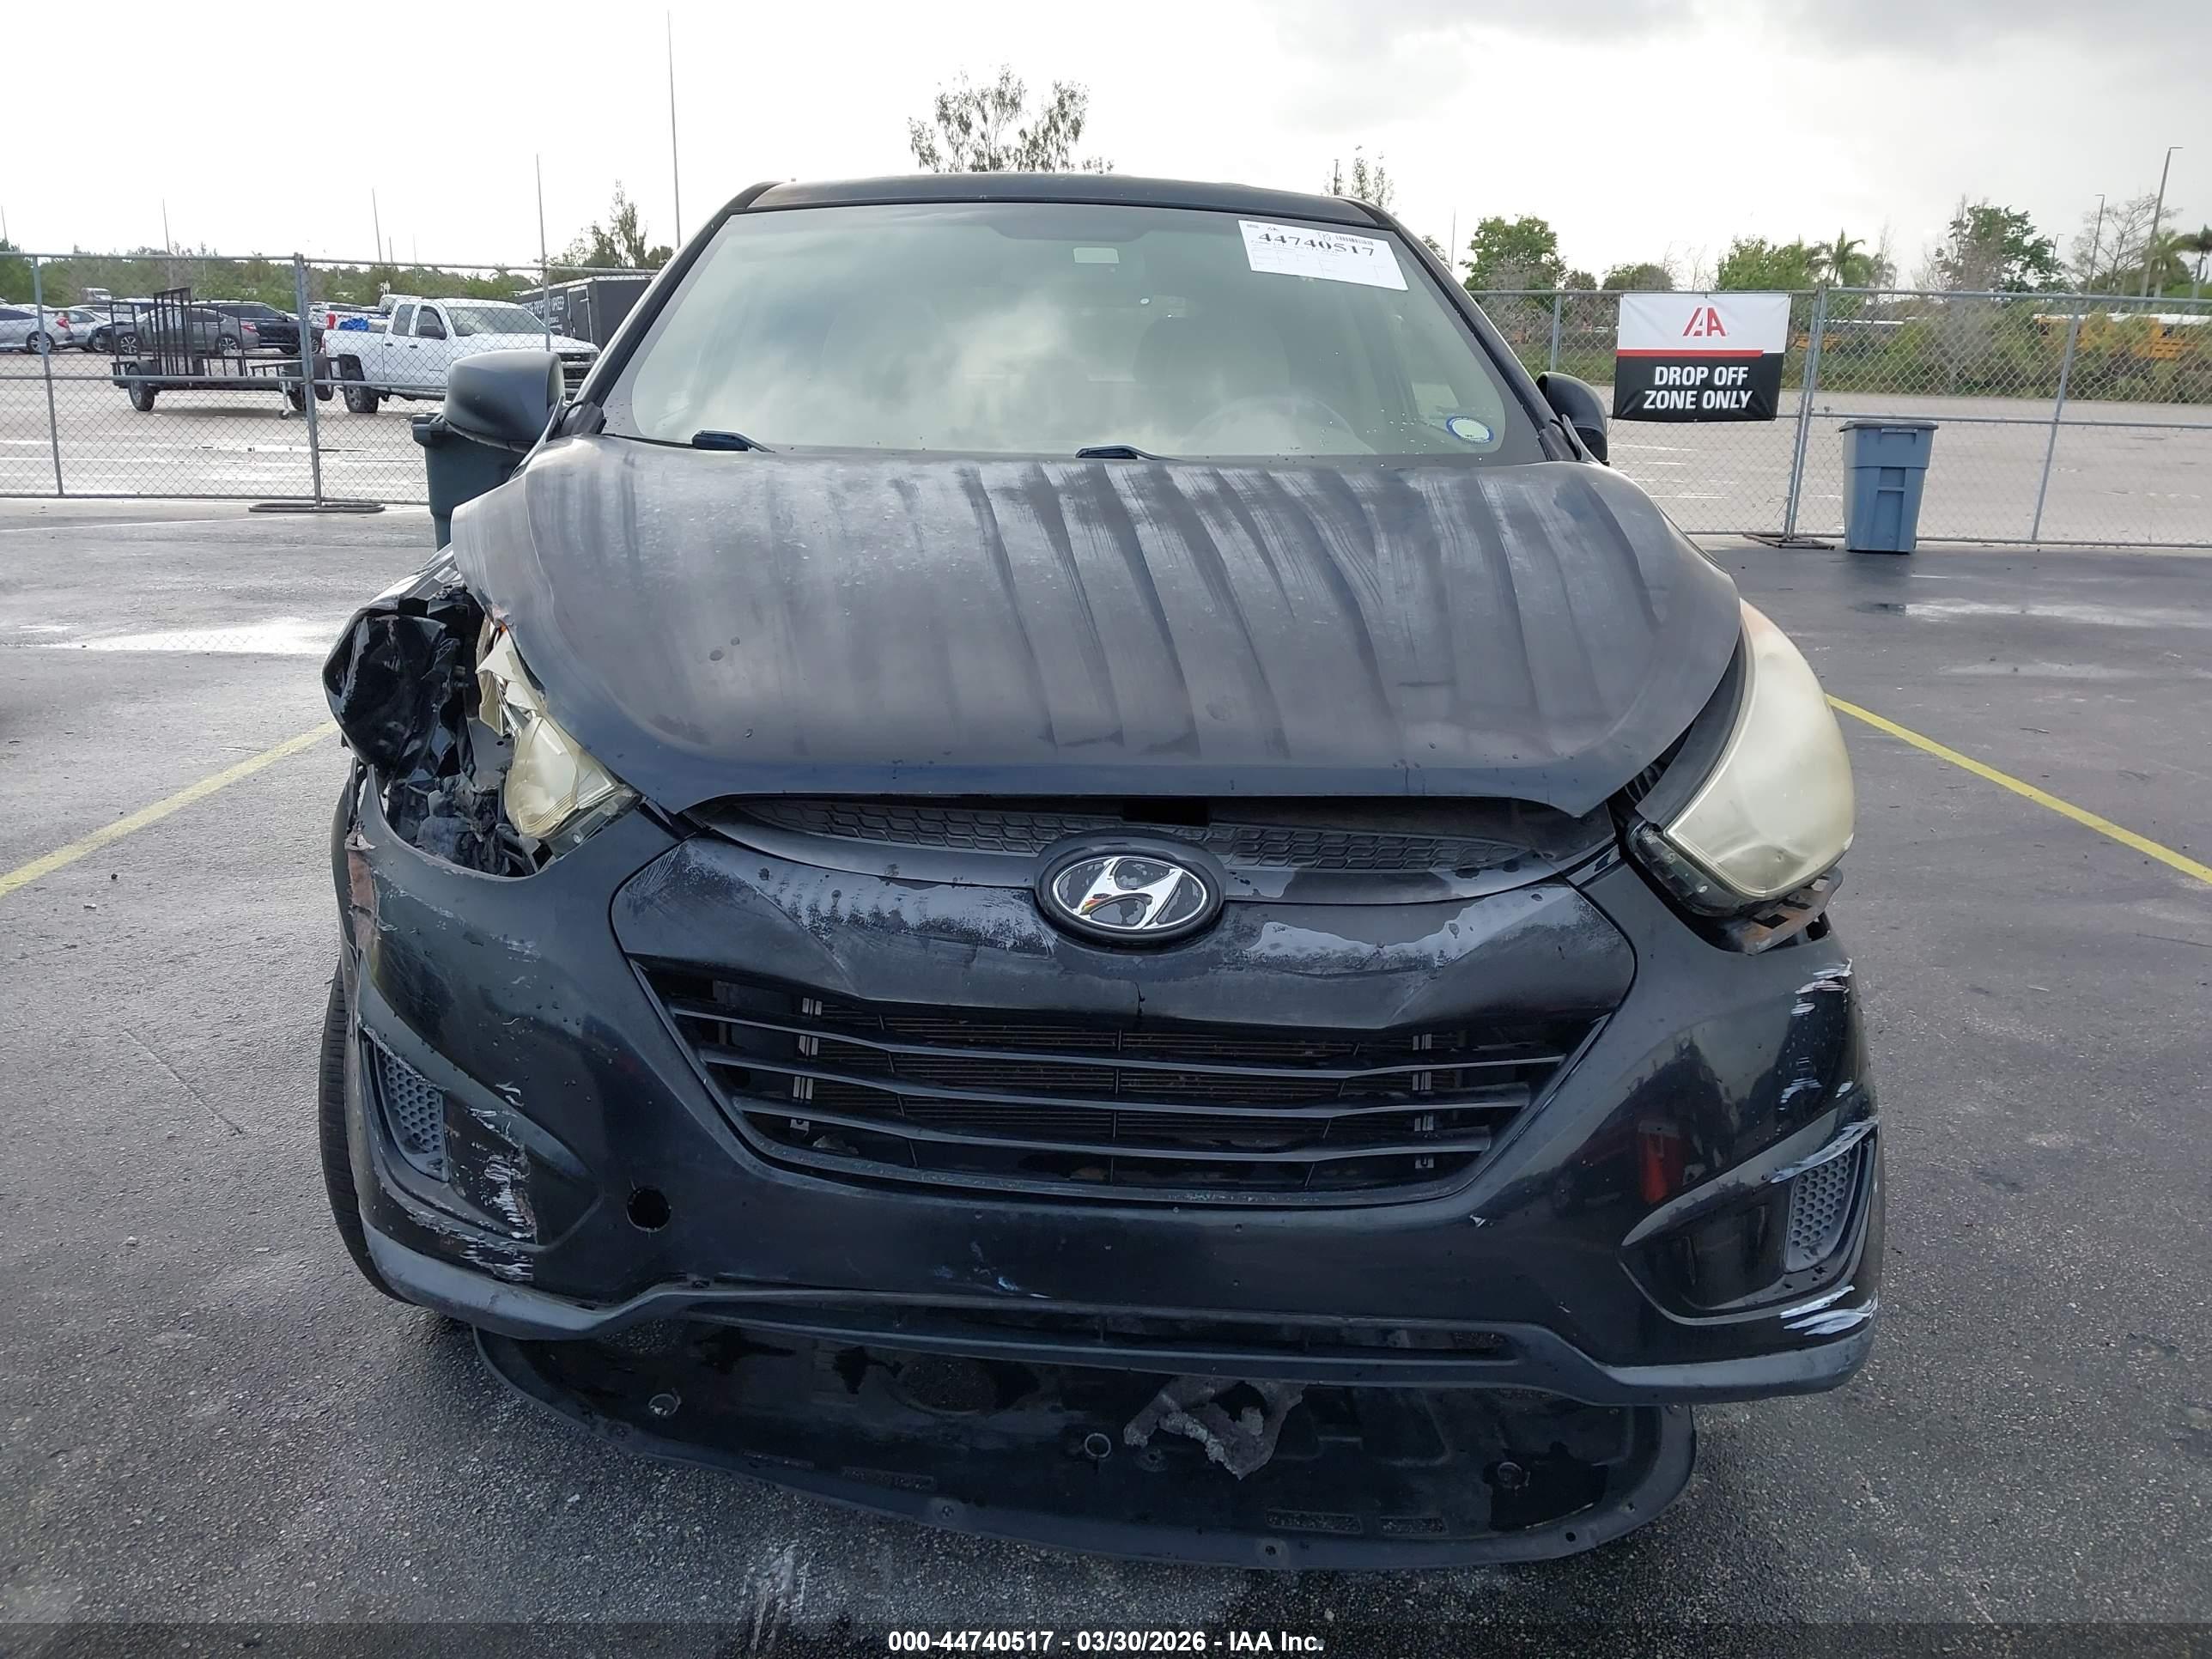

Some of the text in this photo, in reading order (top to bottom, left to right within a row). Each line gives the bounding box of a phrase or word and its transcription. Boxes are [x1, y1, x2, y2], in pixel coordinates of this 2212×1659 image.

[1259, 233, 1374, 256] 44740517
[1654, 366, 1749, 386] DROP OFF
[1643, 390, 1753, 410] ZONE ONLY
